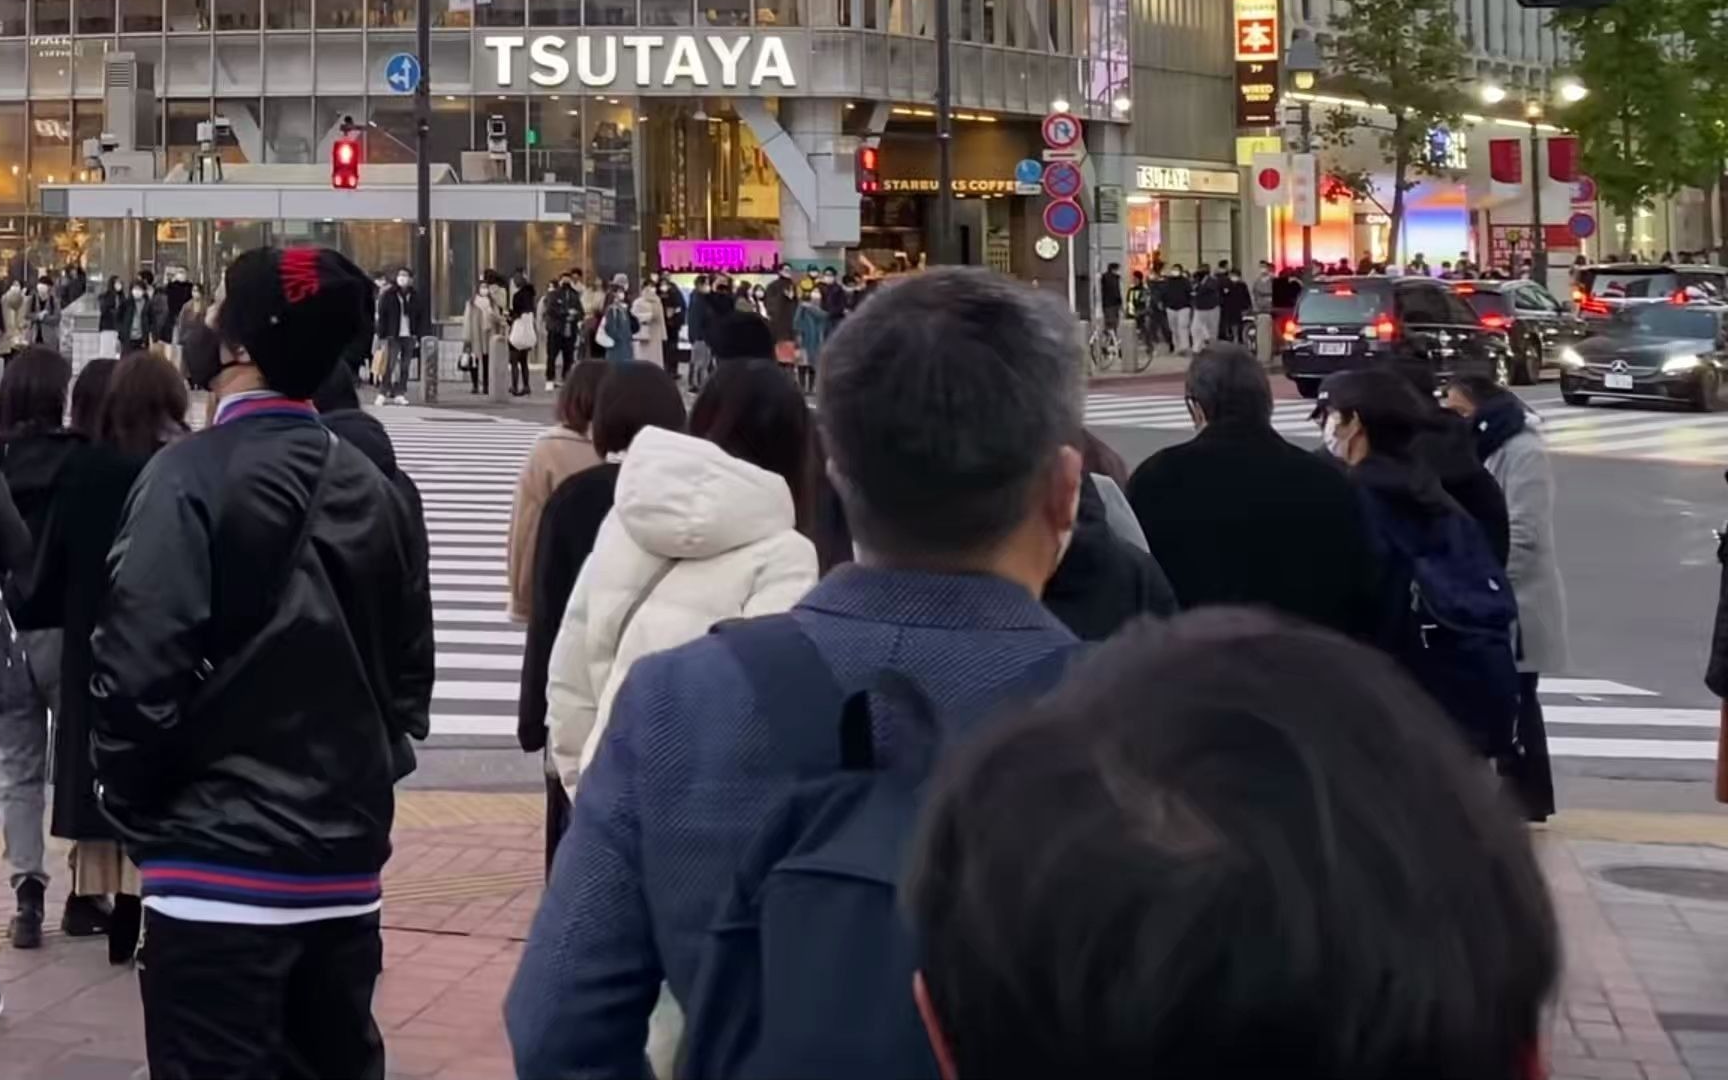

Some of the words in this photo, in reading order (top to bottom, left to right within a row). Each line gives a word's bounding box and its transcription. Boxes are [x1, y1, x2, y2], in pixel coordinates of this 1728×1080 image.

[1241, 22, 1273, 52] 本
[485, 35, 797, 88] TSUTAYA
[1136, 164, 1190, 191] TSUTAYA
